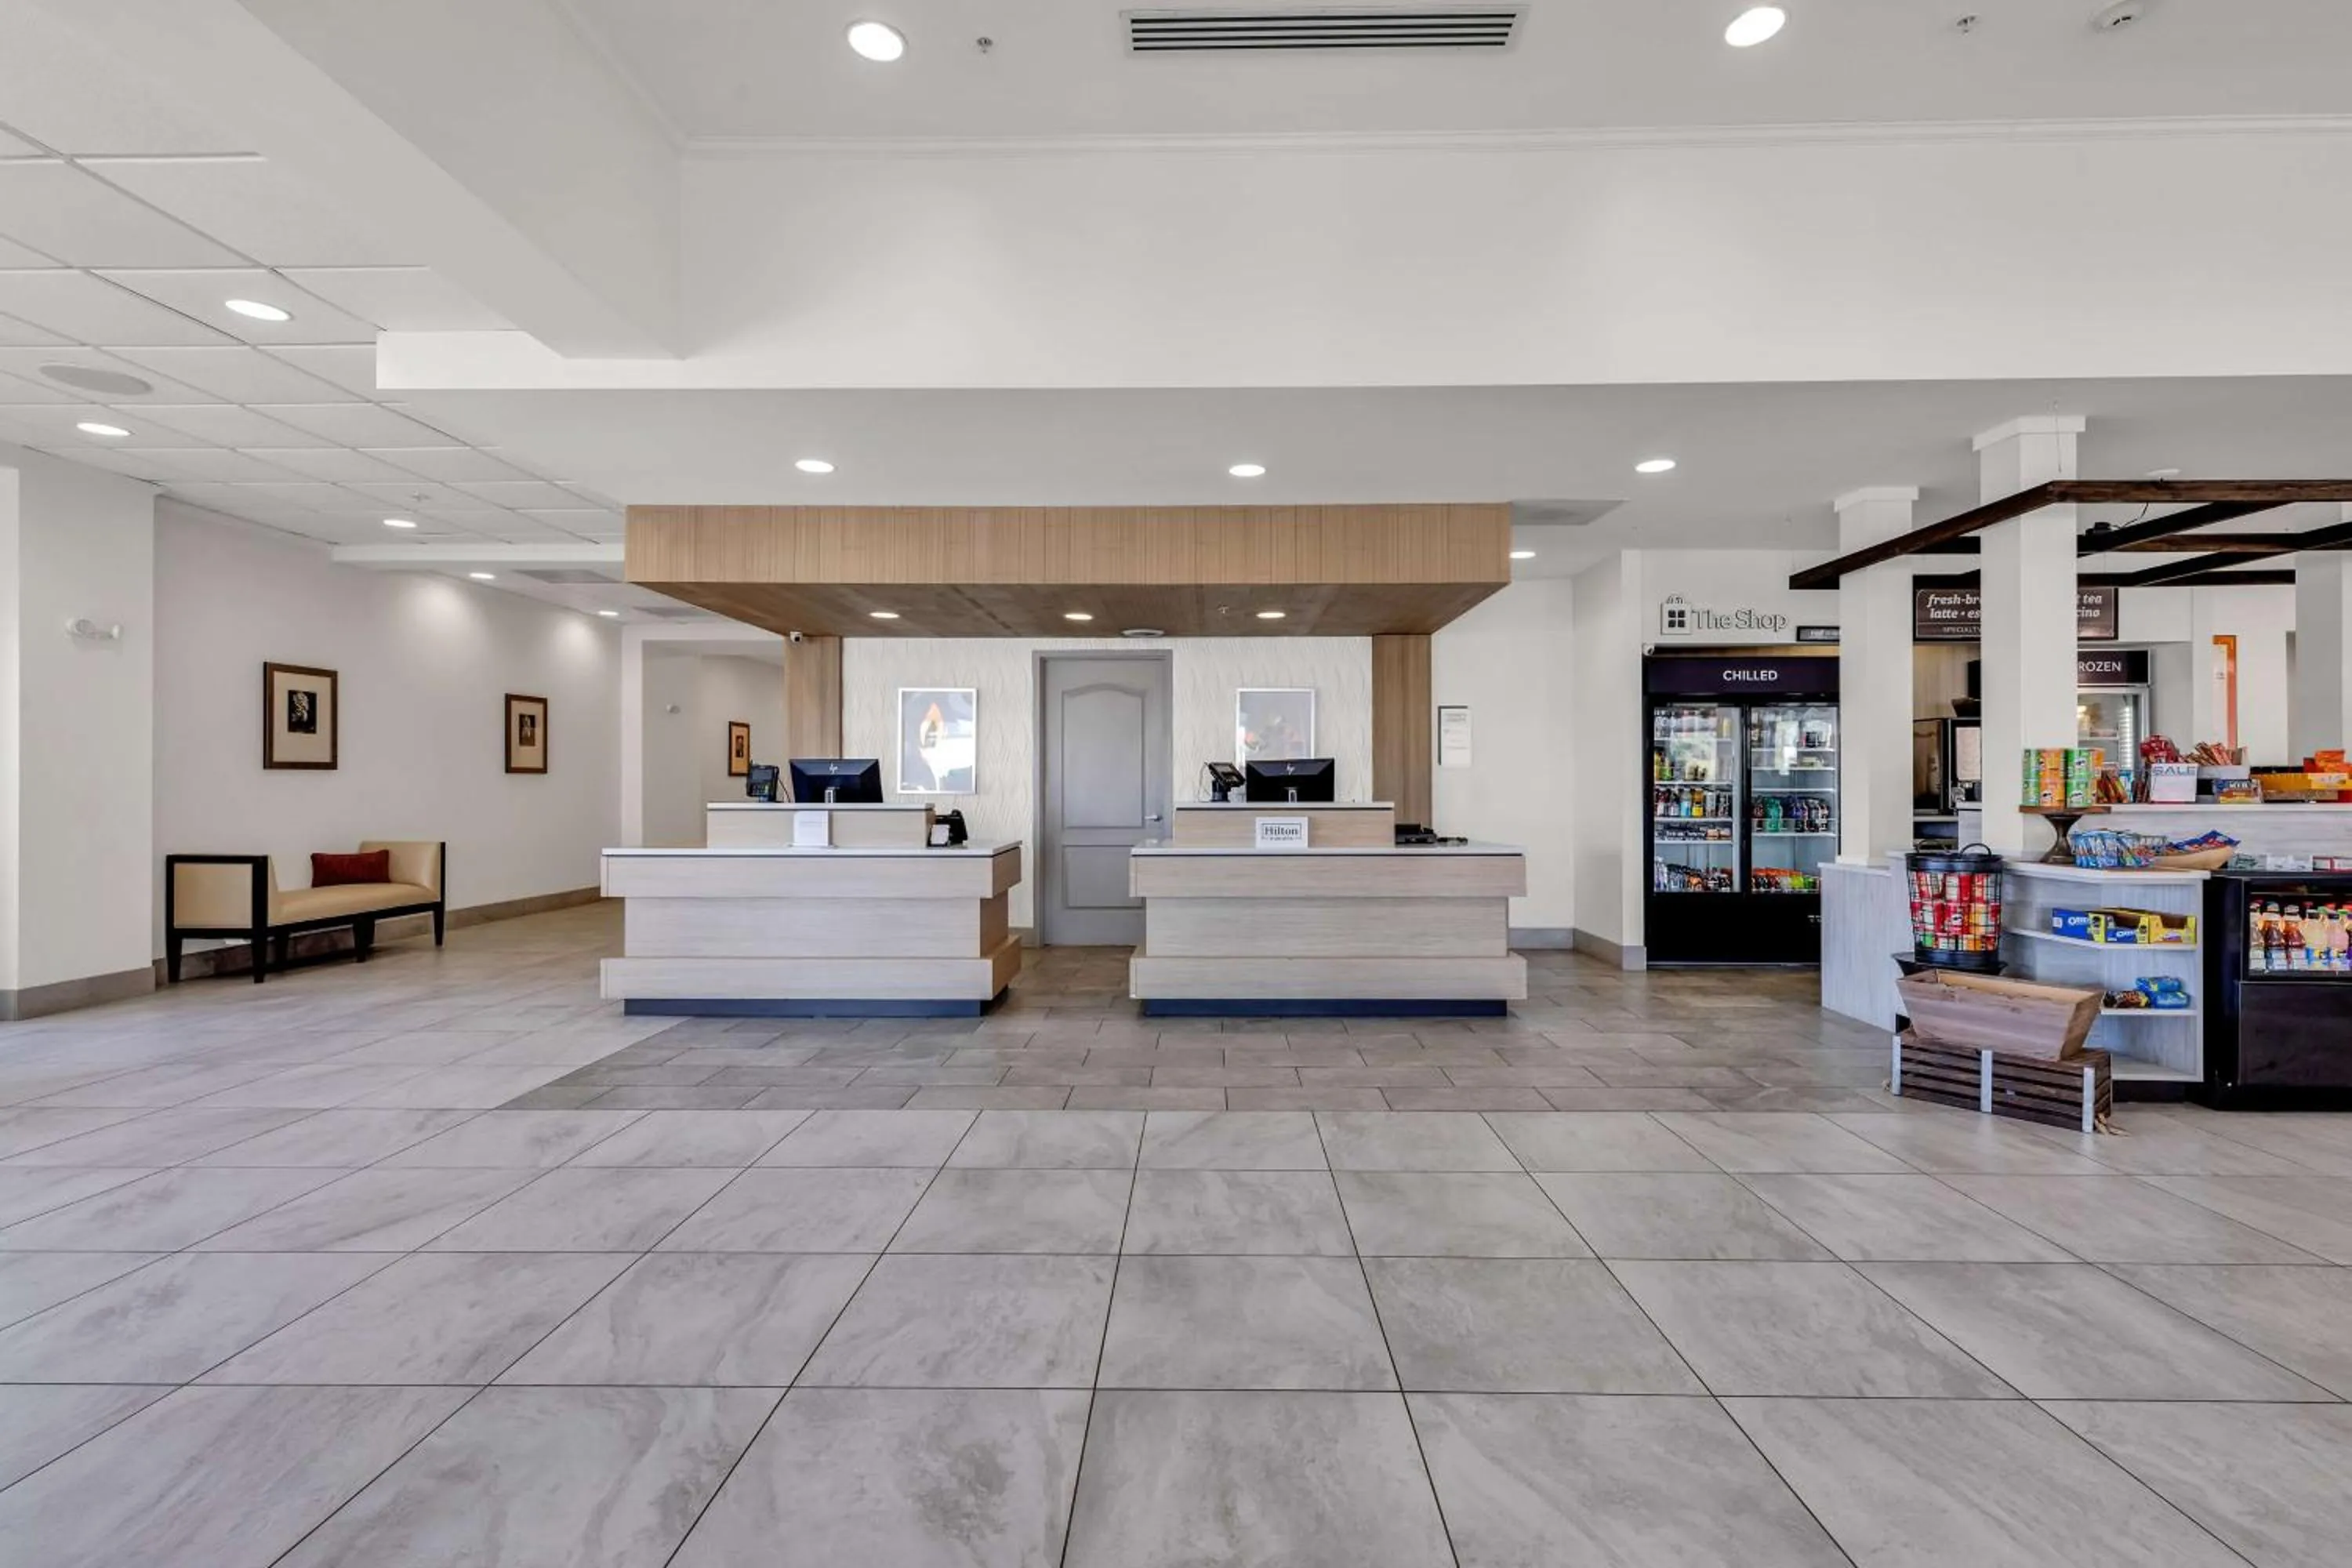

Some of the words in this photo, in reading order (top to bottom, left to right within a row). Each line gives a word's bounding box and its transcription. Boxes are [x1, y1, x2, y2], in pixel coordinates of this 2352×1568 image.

[1926, 593, 1980, 608] fresh-br
[2083, 594, 2102, 604] tea
[1929, 608, 1958, 619] latte
[1692, 609, 1731, 630] The
[1735, 608, 1788, 633] Shop
[2078, 661, 2122, 672] ROZEN
[1722, 670, 1778, 681] CHILLED
[1265, 826, 1299, 835] Hilton
